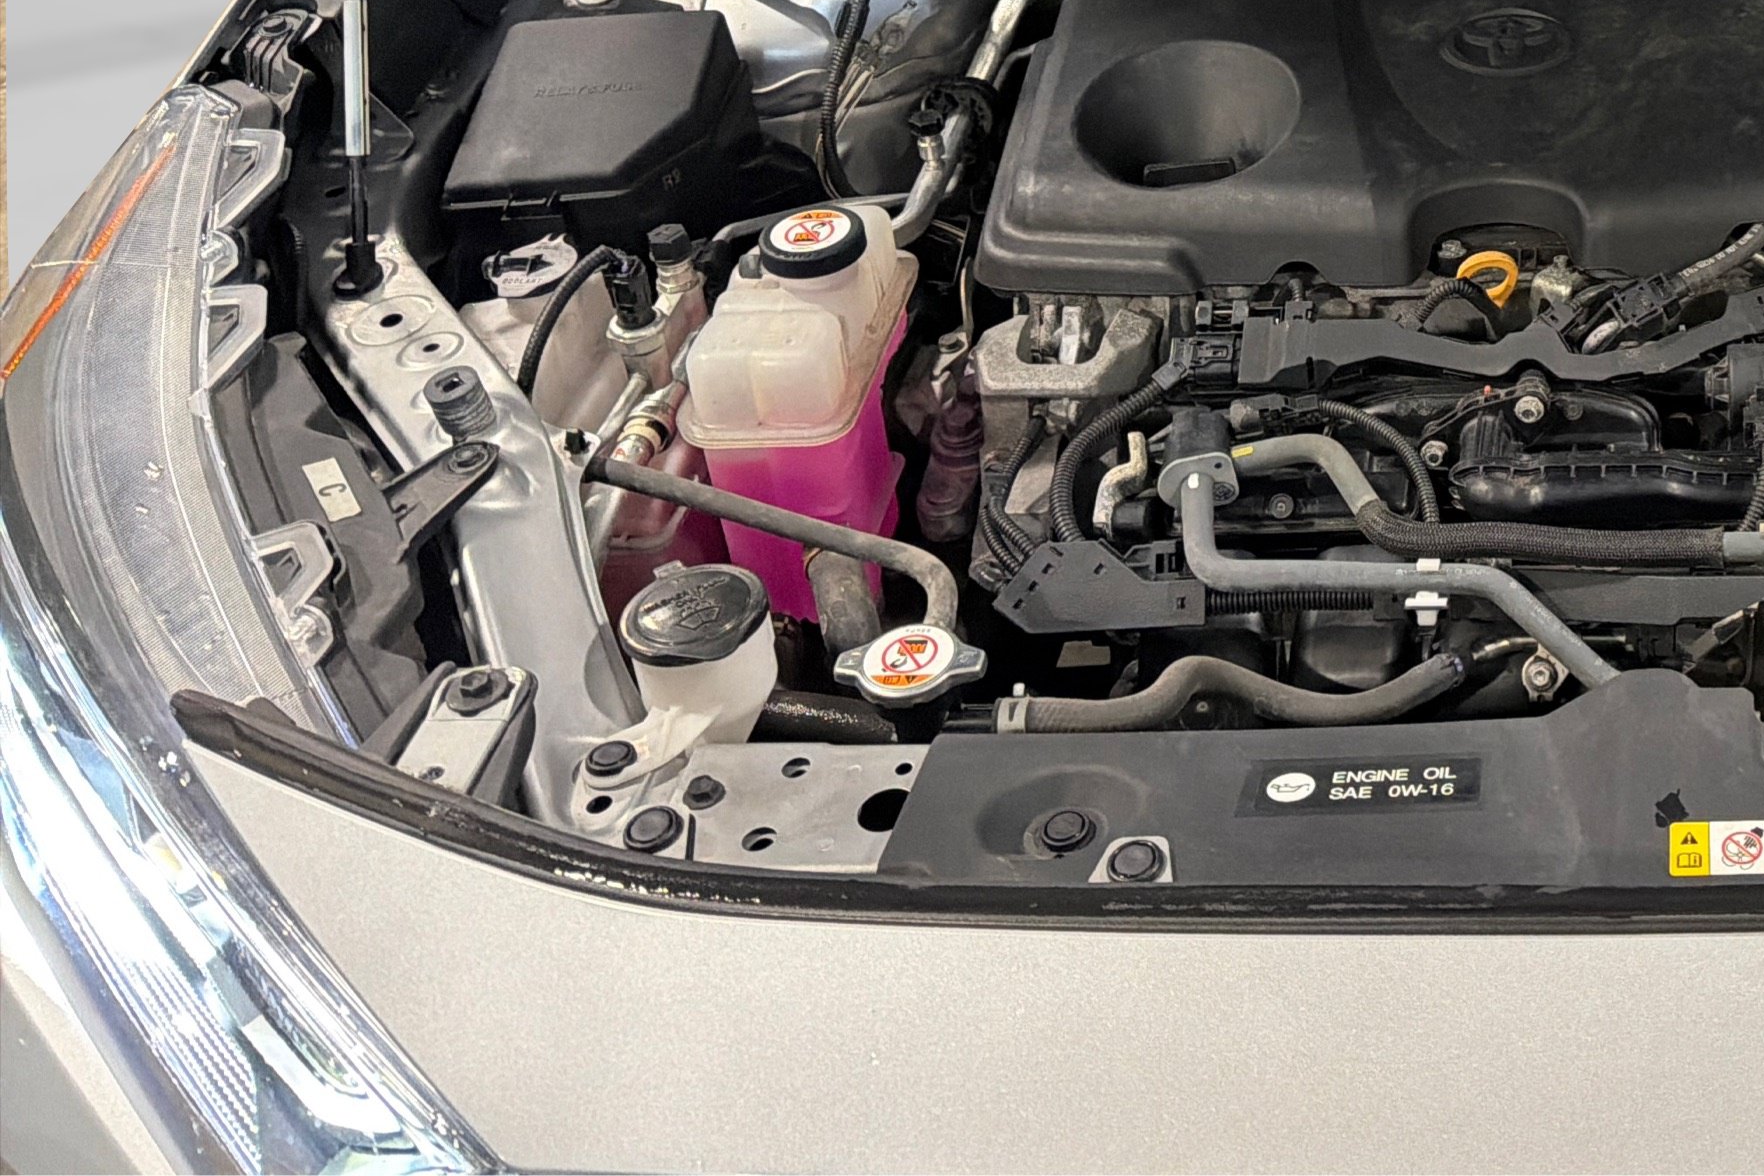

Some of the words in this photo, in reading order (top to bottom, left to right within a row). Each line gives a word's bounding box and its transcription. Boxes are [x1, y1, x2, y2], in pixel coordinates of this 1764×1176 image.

[318, 482, 347, 497] C
[1332, 768, 1410, 784] ENGINE
[1423, 766, 1457, 780] OIL
[1329, 786, 1373, 801] SAE
[1388, 783, 1455, 798] 0W-16
